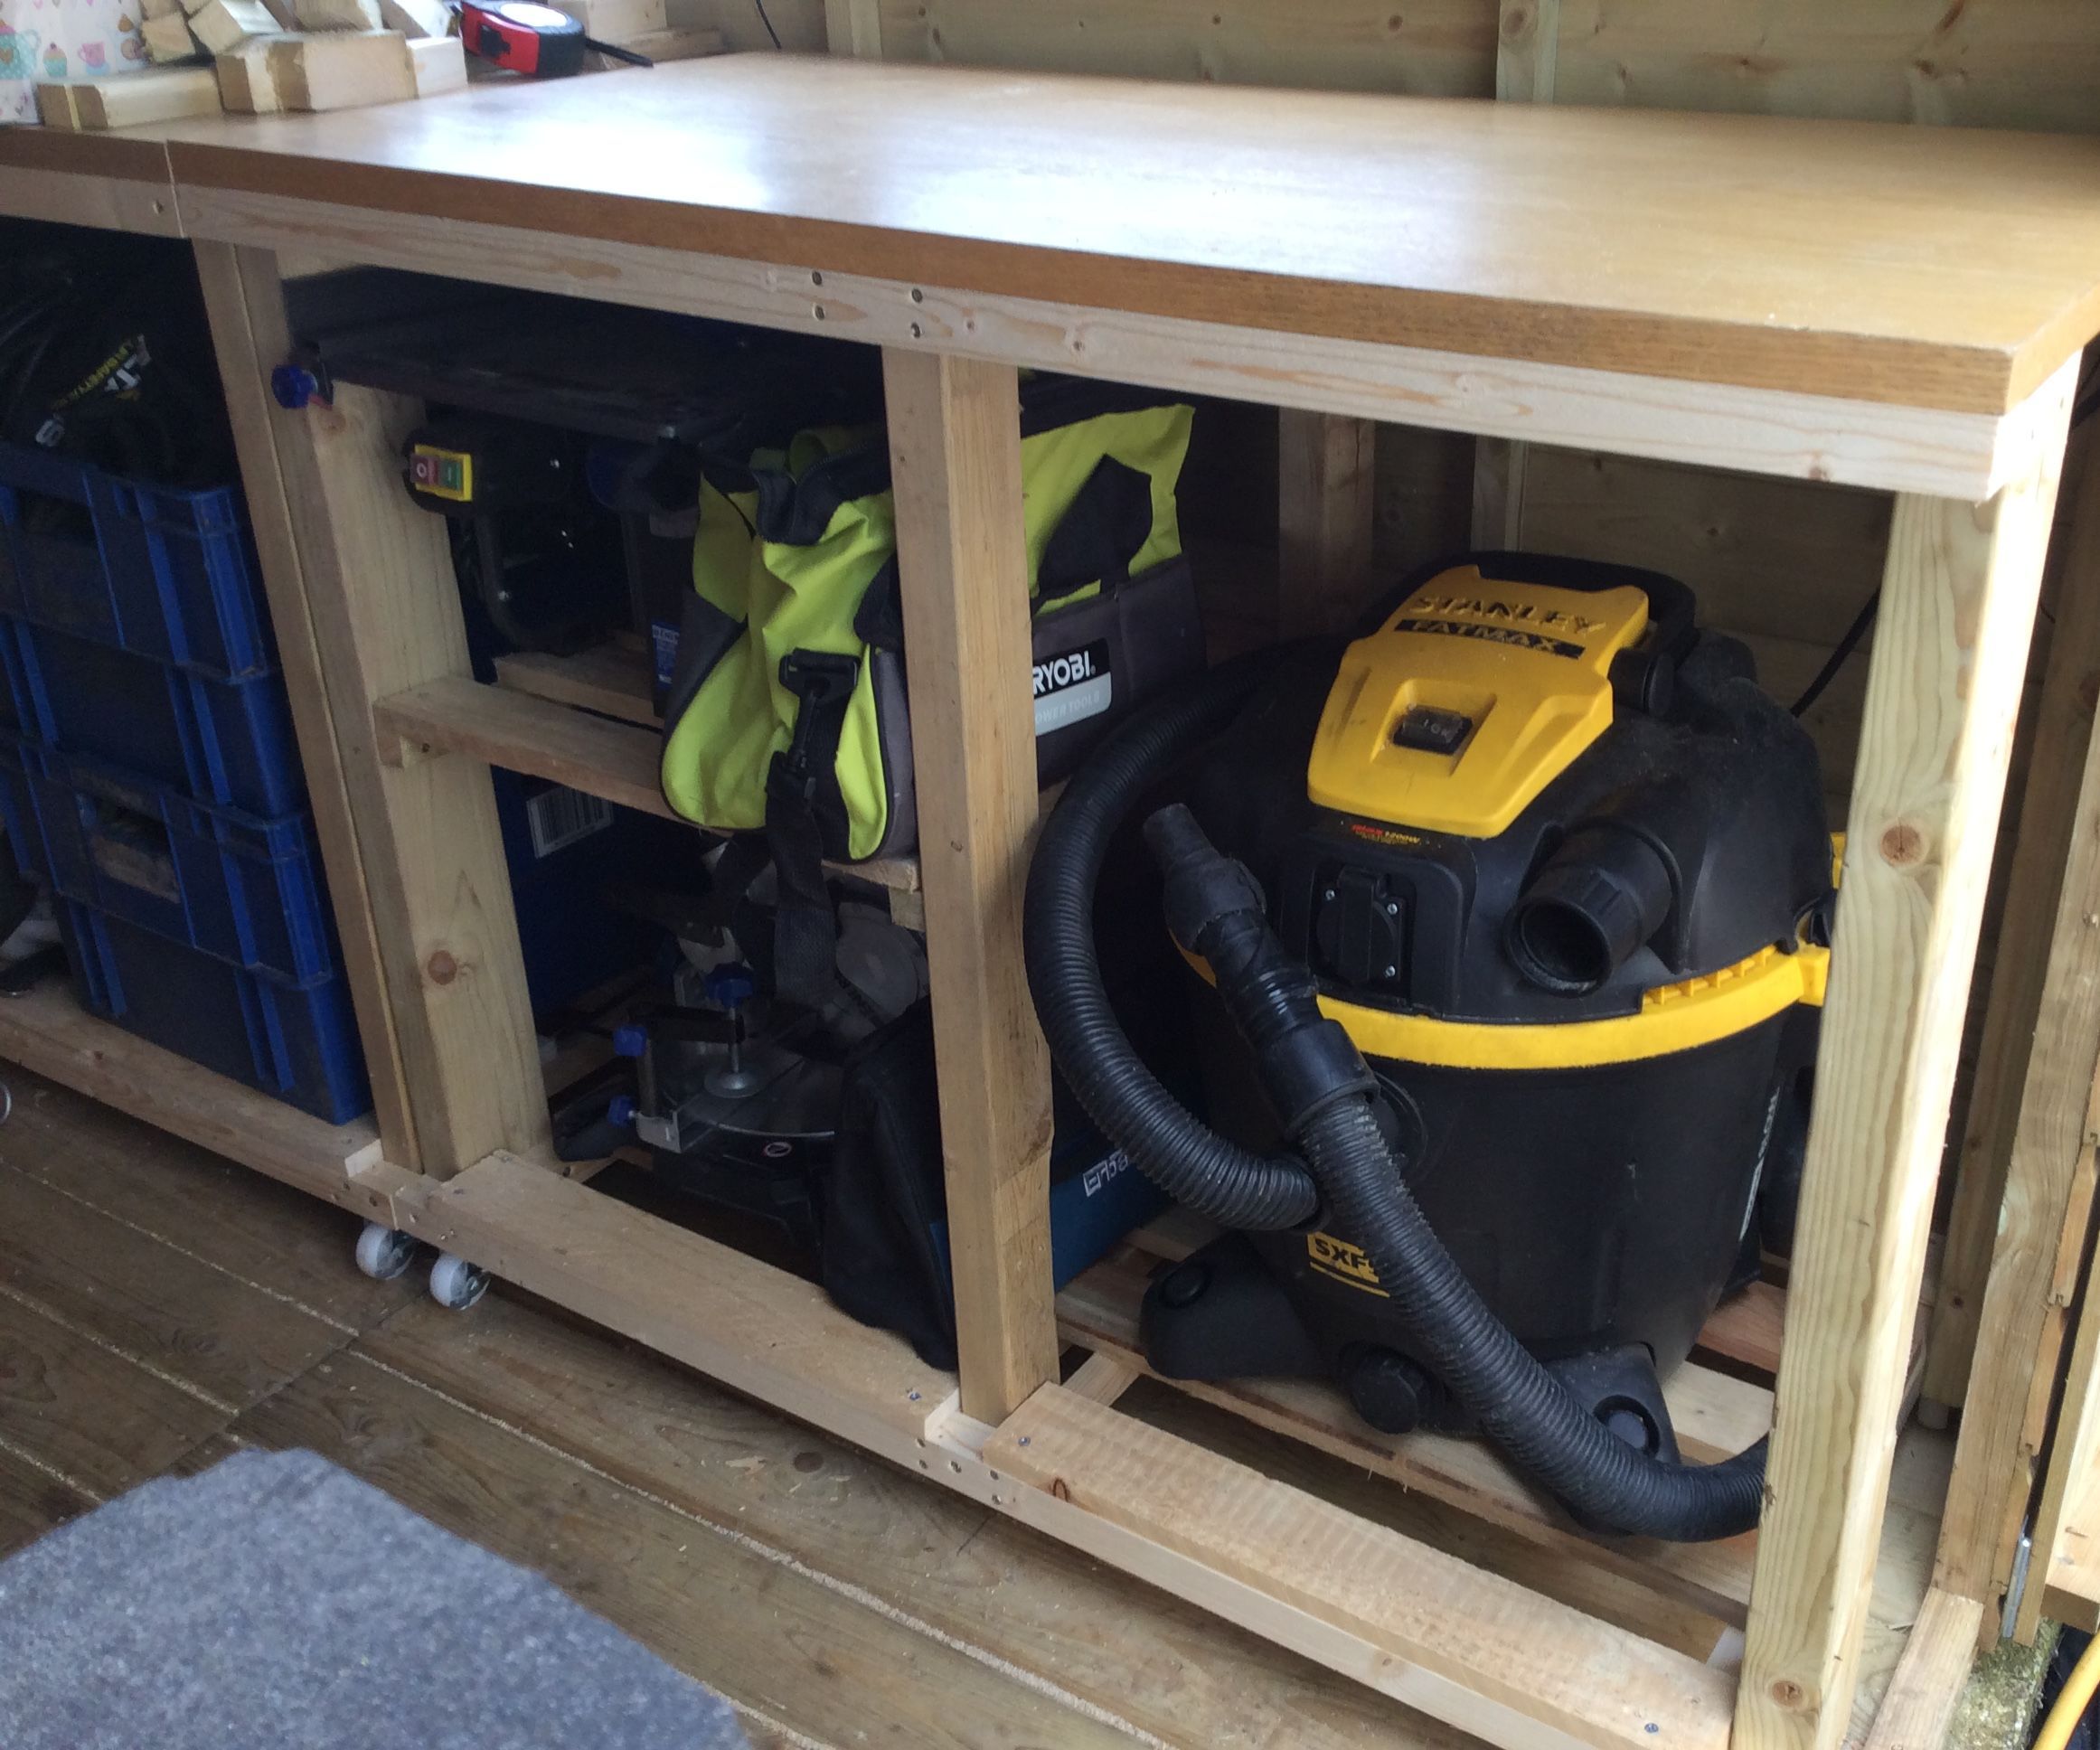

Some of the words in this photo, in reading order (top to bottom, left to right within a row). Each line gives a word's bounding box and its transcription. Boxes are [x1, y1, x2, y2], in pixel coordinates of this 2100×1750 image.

[1408, 597, 1607, 635] STANLEY
[1412, 620, 1557, 656] FATMAX
[1032, 650, 1091, 695] RYOBI
[1034, 704, 1068, 723] OWER
